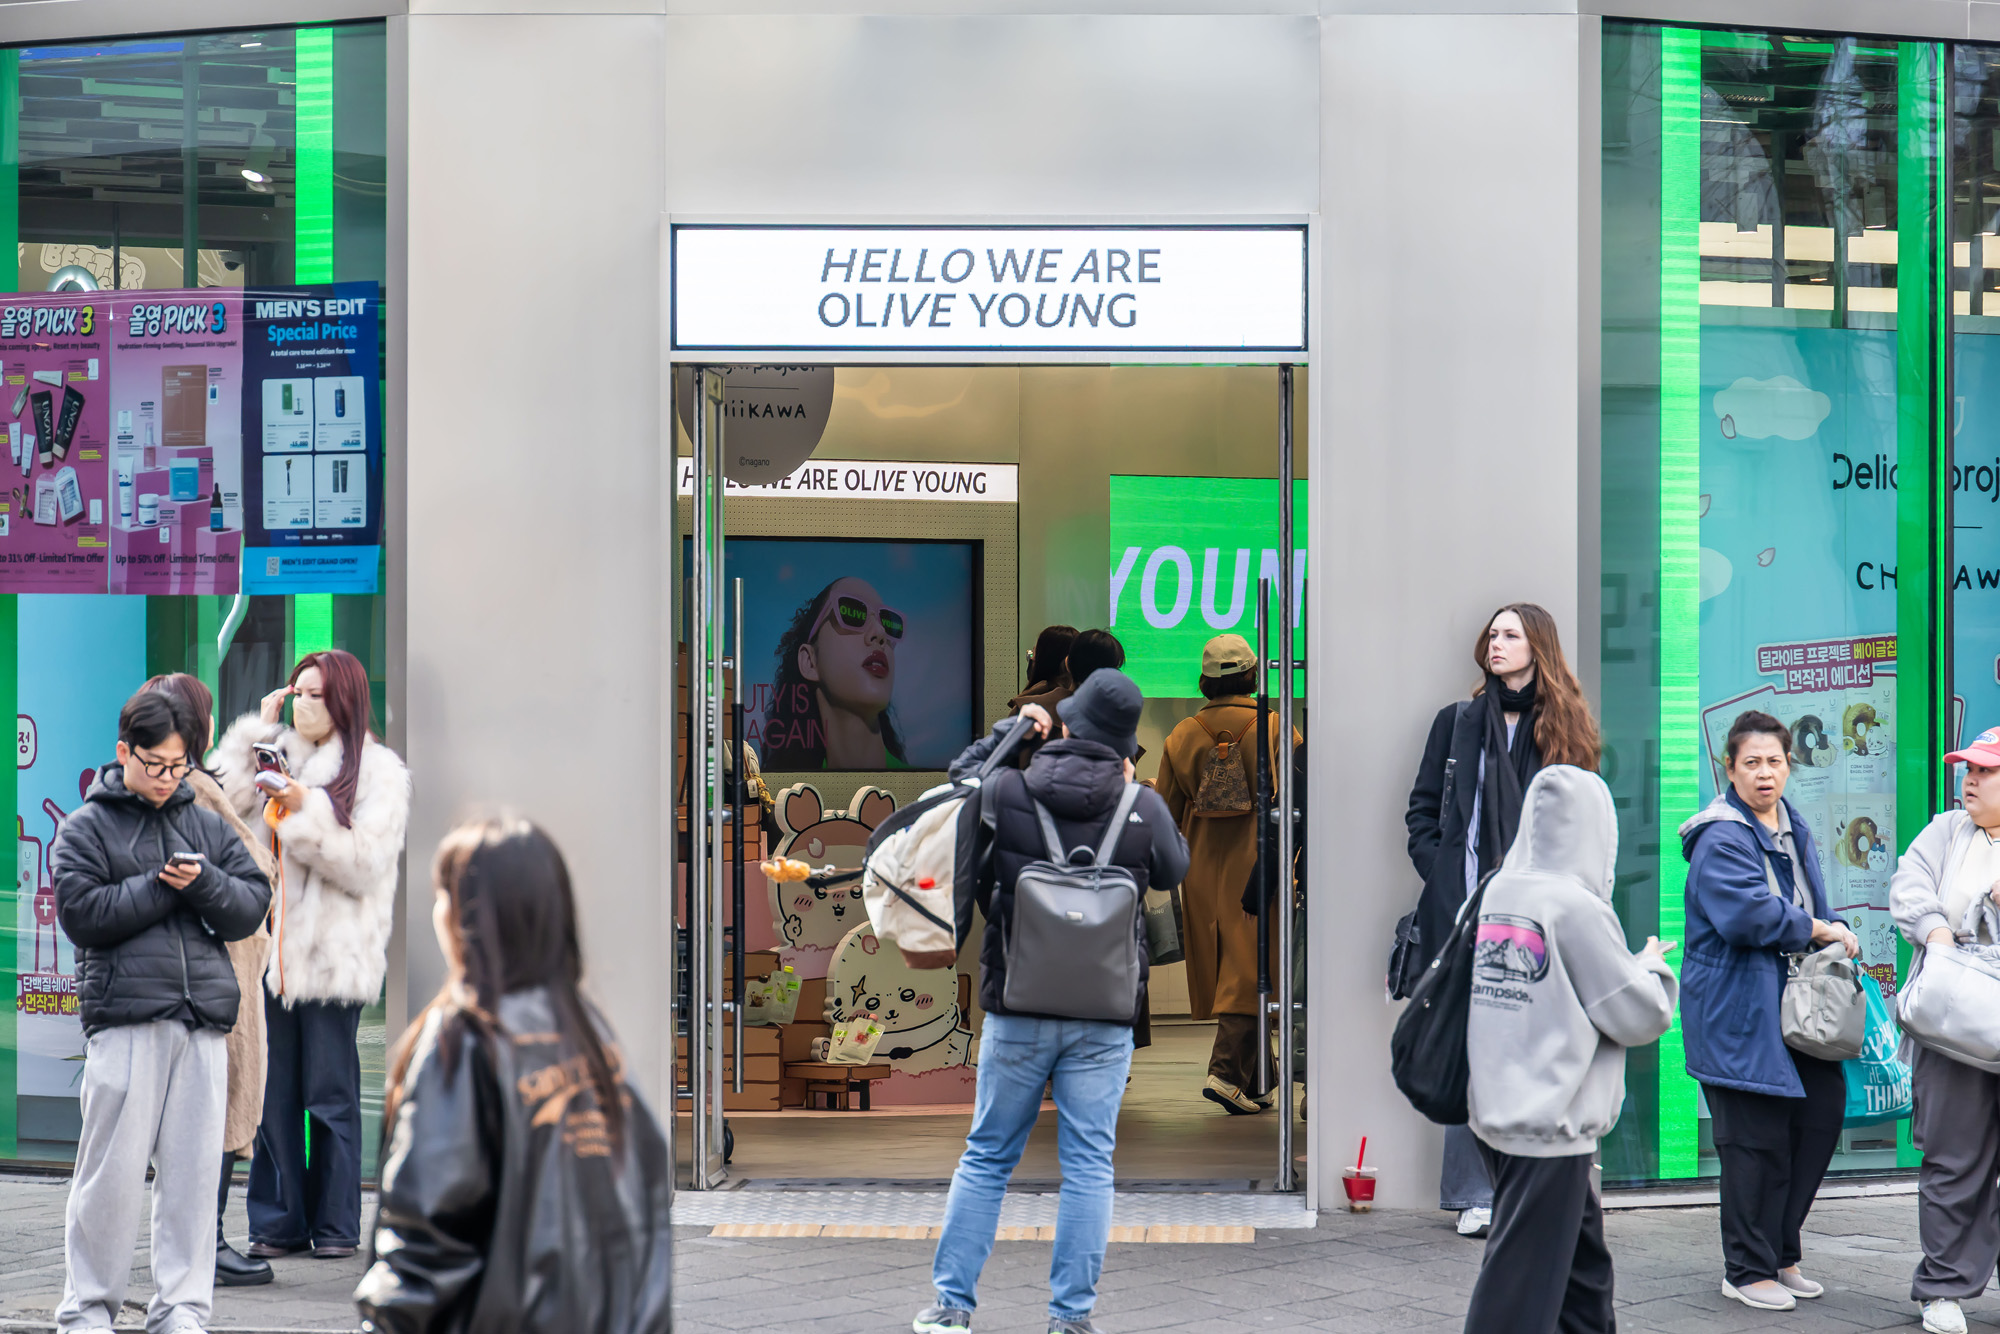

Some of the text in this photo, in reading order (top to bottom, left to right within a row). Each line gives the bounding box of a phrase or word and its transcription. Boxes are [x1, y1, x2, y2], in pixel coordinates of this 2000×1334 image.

[821, 248, 1162, 284] HELLO WE ARE
[256, 298, 367, 318] MEN'S EDIT
[818, 292, 1137, 328] OLIVE YOUNG
[268, 320, 358, 346] Special Price
[797, 468, 838, 491] ARE
[844, 470, 908, 493] OLIVE
[912, 471, 988, 495] YOUNG
[8, 553, 23, 563] 31%
[68, 552, 85, 563] Time
[116, 554, 127, 566] Up
[128, 554, 136, 563] to
[199, 552, 216, 562] Time
[839, 604, 867, 620] OLIVE
[1760, 640, 1897, 669] 딜라이트 프로젝트 베이글칩
[1789, 663, 1871, 690] 먼작귀 에디션
[792, 683, 810, 714] IS
[745, 718, 829, 749] AGAIN
[26, 993, 58, 1012] 먼작귀
[1473, 984, 1534, 1004] ampside.
